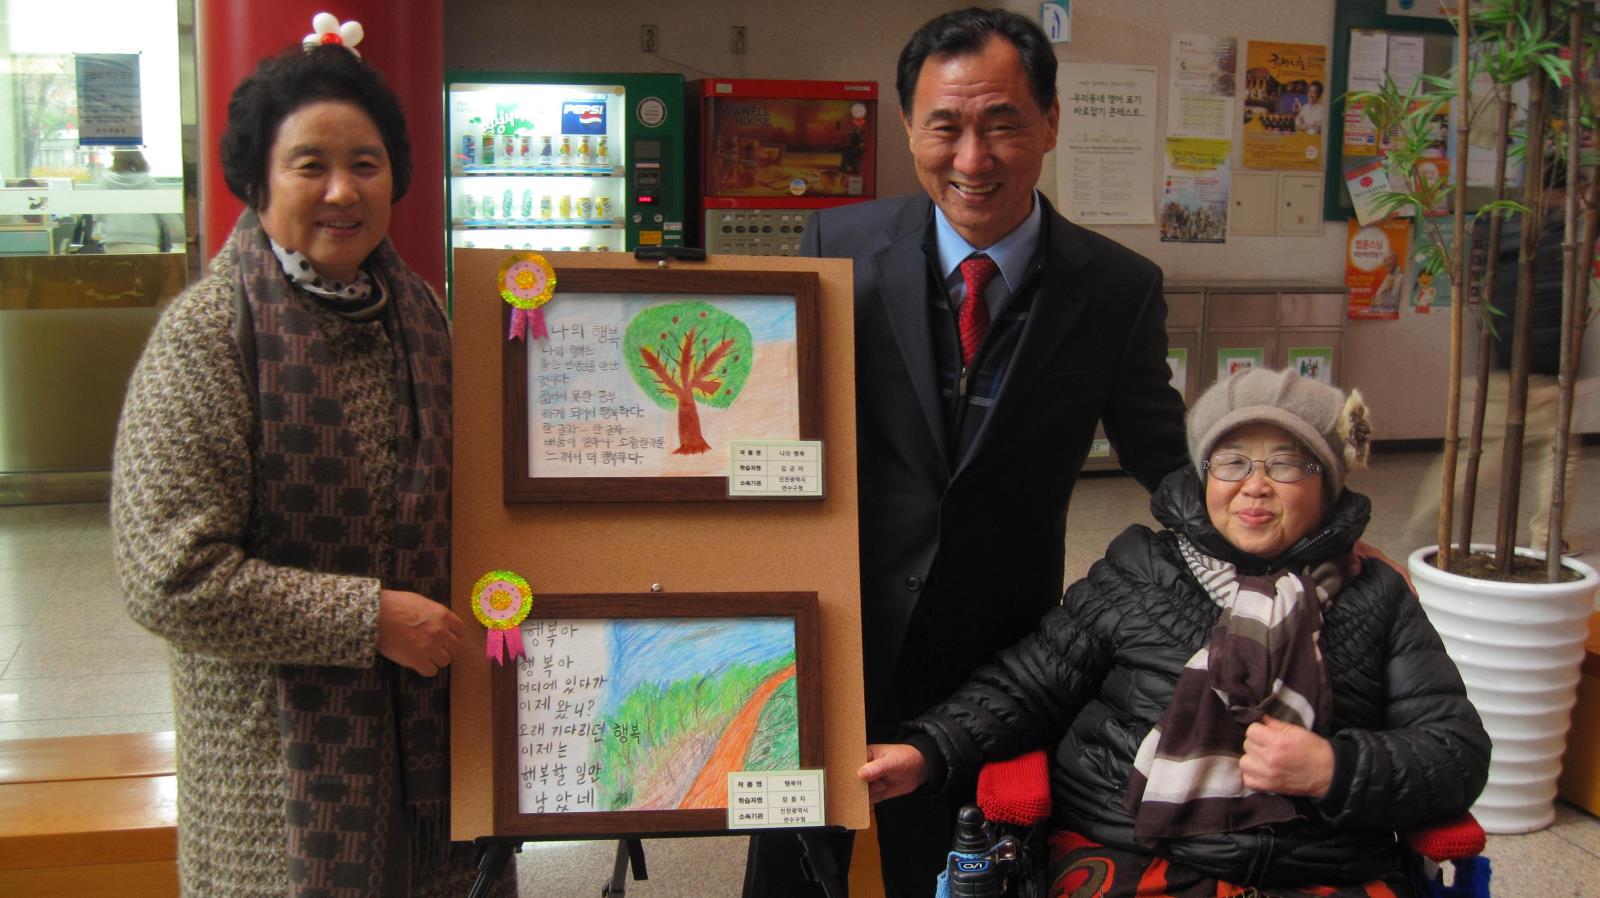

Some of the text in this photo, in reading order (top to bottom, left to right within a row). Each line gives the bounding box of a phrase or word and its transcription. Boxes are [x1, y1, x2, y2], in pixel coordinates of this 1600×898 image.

[563, 104, 604, 114] PEPSI
[551, 324, 620, 348] 나의 행복
[586, 453, 597, 465] 더
[523, 622, 579, 647] 행복아
[520, 675, 608, 694] 어디에 있다가
[520, 696, 595, 720] 이제 왔니?
[519, 722, 641, 744] 오래 기다리던 행복
[521, 763, 602, 789] 행복할 일만
[535, 788, 594, 813] 남았네
